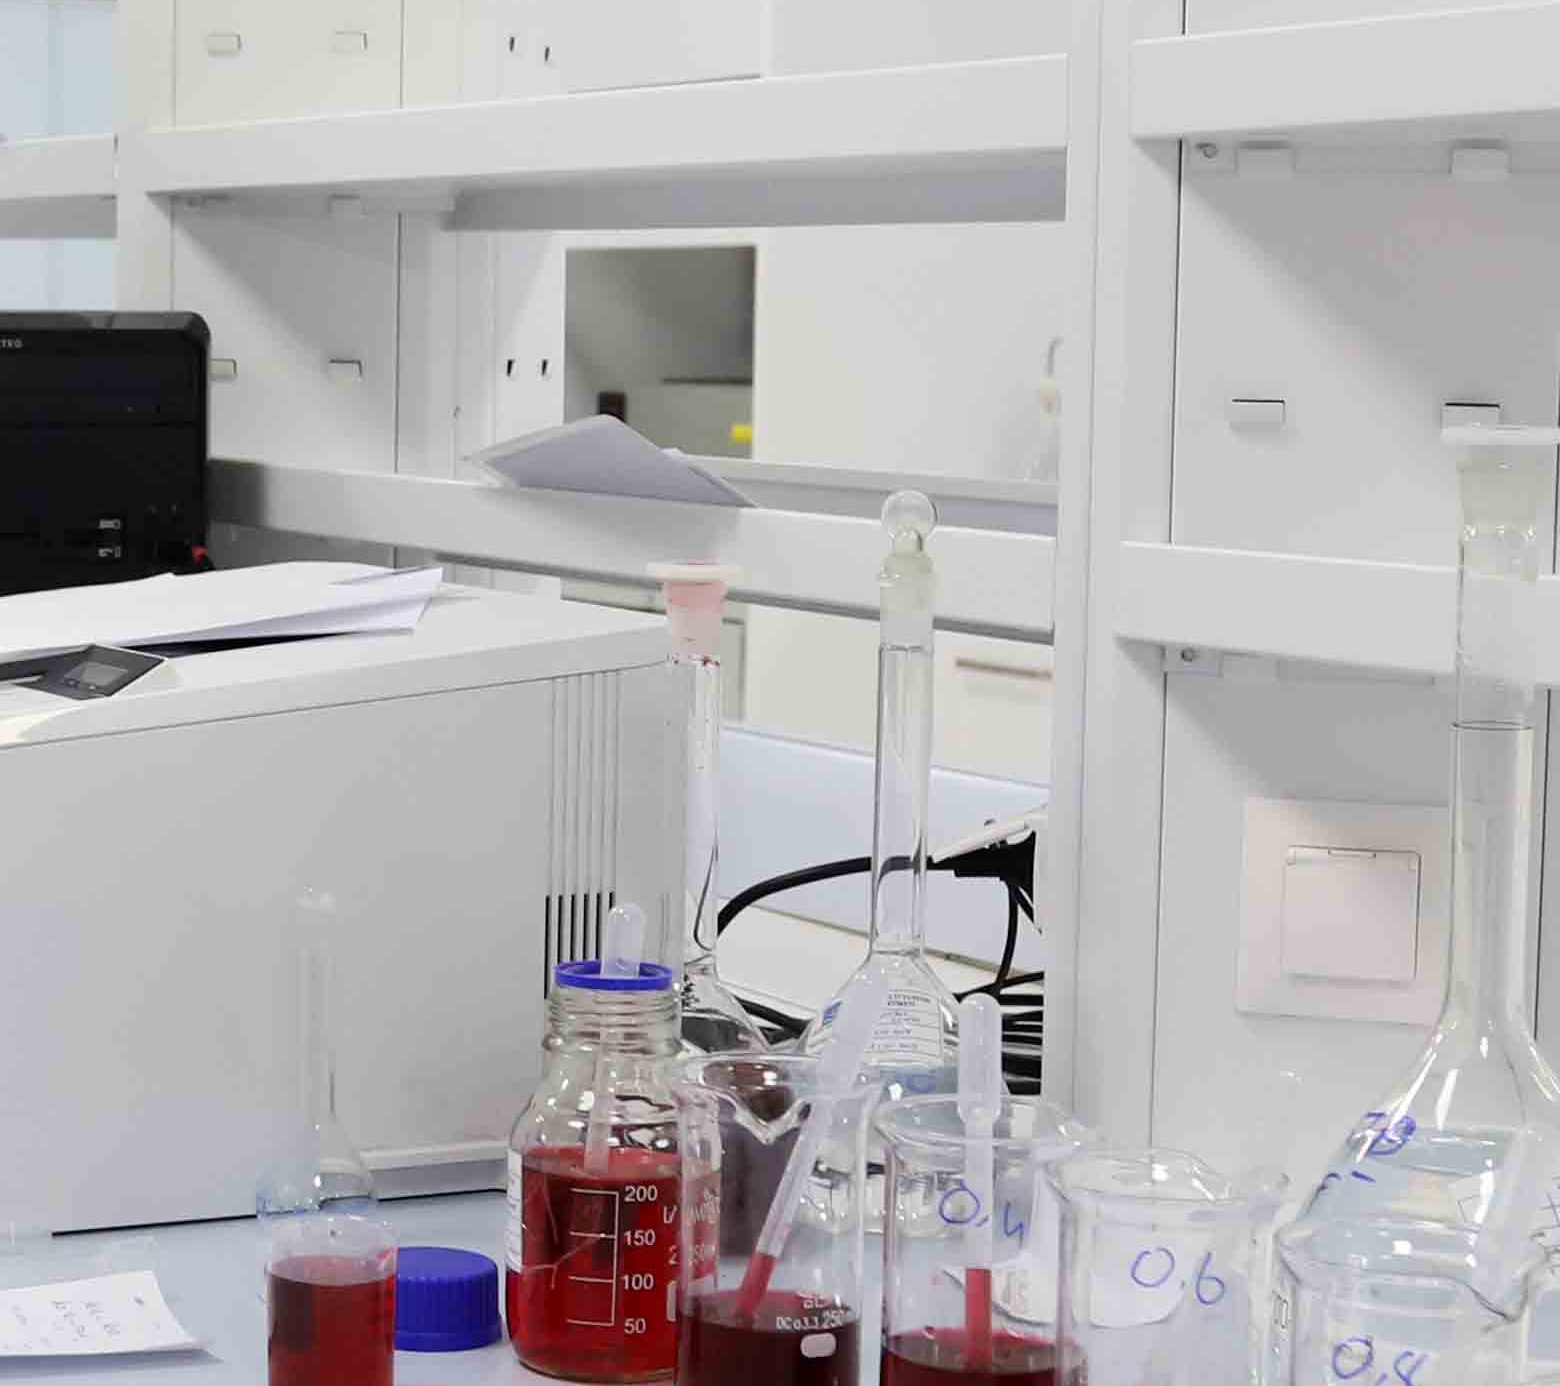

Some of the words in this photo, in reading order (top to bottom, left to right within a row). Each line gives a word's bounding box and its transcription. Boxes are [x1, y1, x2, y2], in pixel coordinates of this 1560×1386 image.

[623, 1185, 658, 1202] 200
[623, 1229, 656, 1246] 150
[623, 1273, 655, 1290] 100
[623, 1317, 647, 1334] 50
